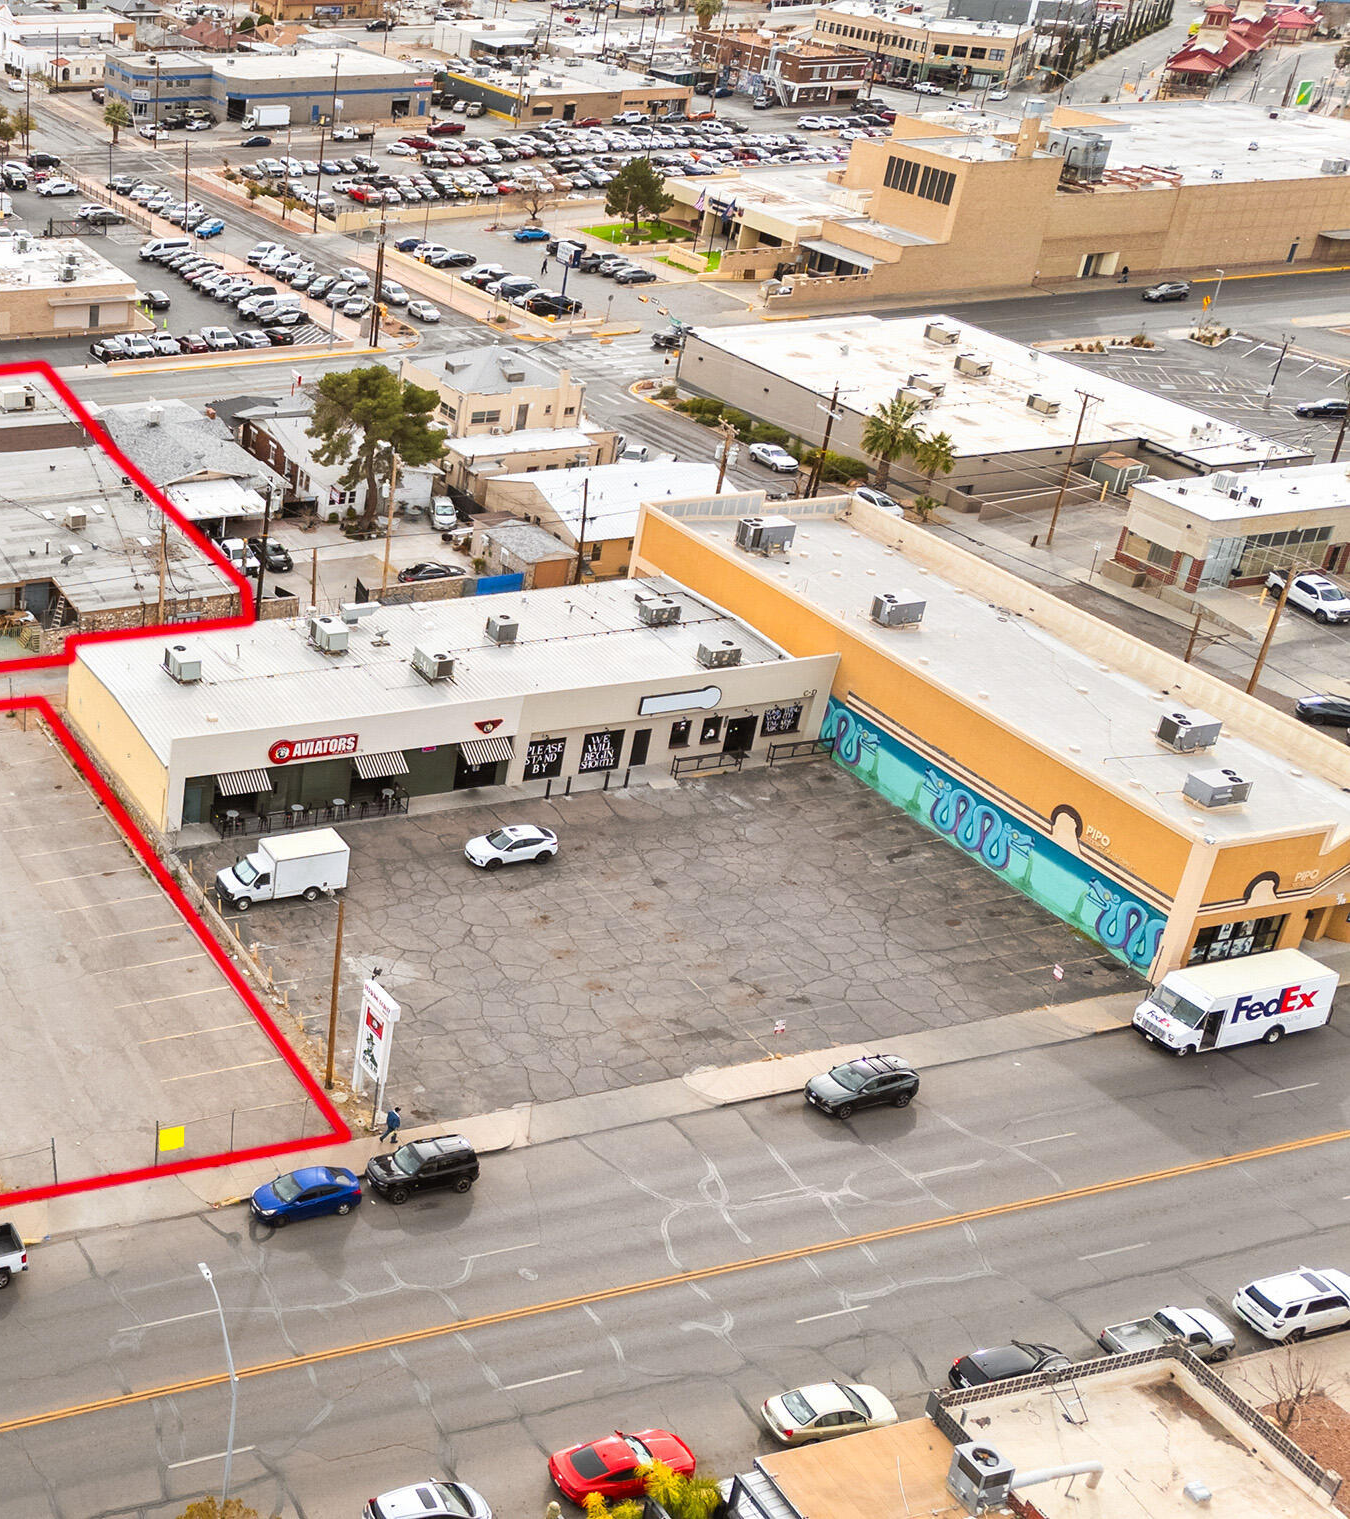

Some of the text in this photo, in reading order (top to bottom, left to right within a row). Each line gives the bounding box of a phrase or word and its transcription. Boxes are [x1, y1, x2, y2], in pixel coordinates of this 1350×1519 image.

[591, 734, 610, 744] WE
[292, 736, 355, 757] AVIATORS
[528, 742, 564, 755] PLEASE
[588, 742, 613, 752] WILL
[525, 753, 557, 765] STAND
[584, 749, 614, 761] BEGIN
[532, 763, 548, 774] BY
[1085, 825, 1110, 847] PIPO
[1294, 869, 1319, 882] PIPO
[1231, 985, 1319, 1024] FedEx
